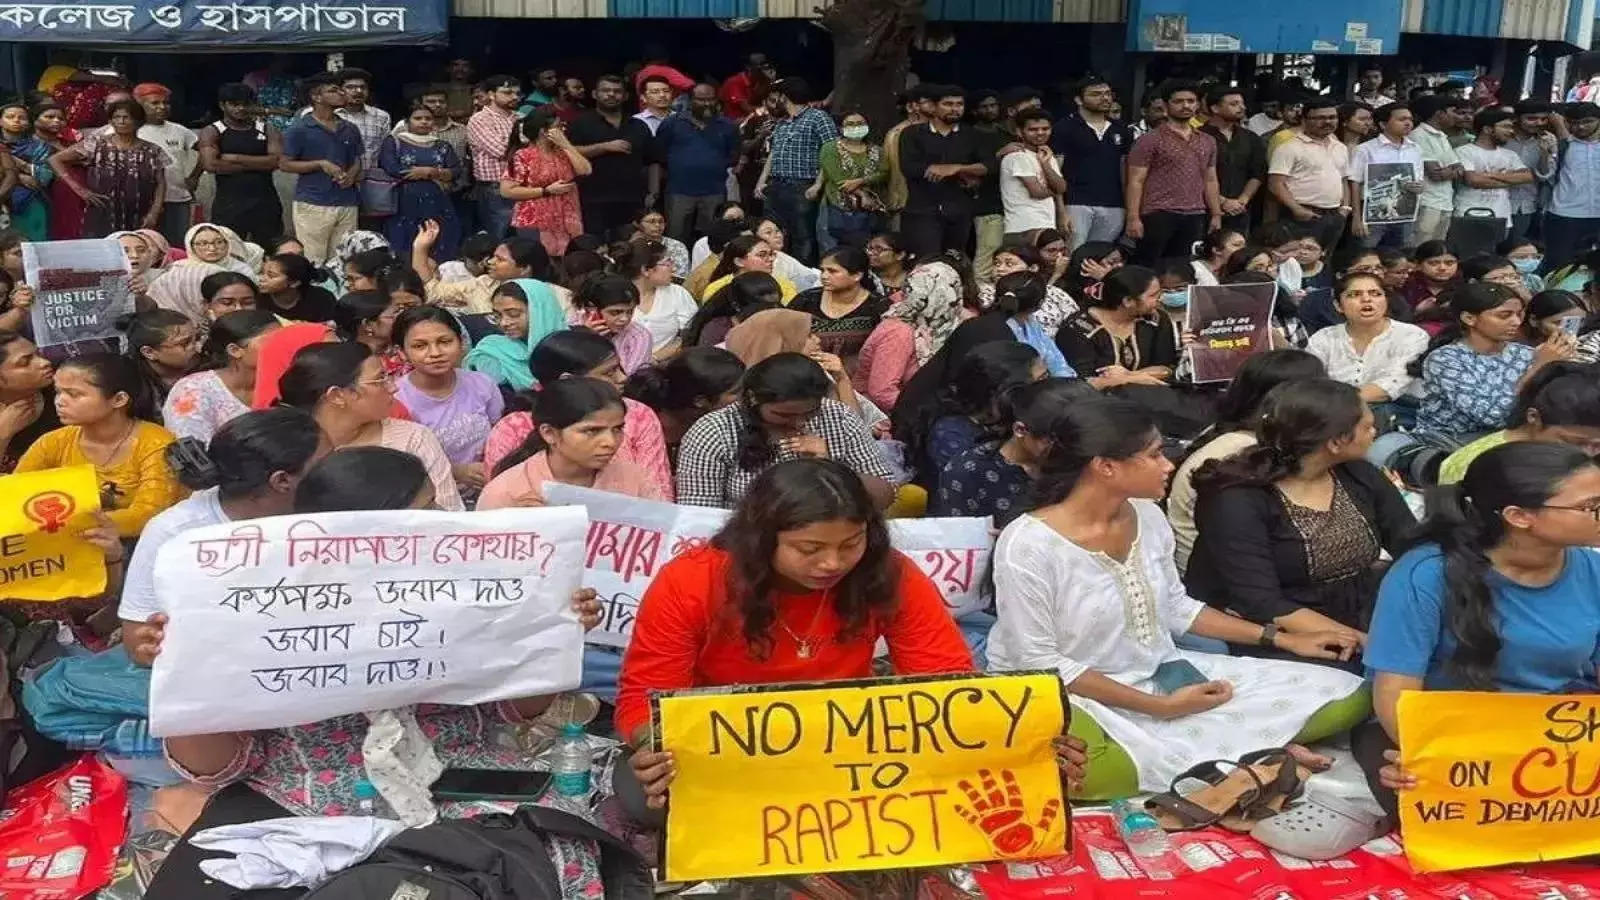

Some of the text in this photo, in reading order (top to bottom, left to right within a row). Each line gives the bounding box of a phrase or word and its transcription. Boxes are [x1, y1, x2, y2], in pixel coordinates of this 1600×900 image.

[0, 2, 406, 32] কলেজ ও হাসপাতাল
[46, 289, 105, 305] JUSTICE
[46, 304, 74, 318] FOR
[47, 314, 97, 330] VICTIM
[189, 524, 270, 577] ছাত্রী
[219, 577, 524, 618] কর্তৃপক্ষ জবাব দাও
[261, 623, 356, 653] জবাব
[250, 663, 347, 693] জবাব
[708, 685, 1033, 756] NO MERCY
[834, 762, 909, 792] TO
[1449, 760, 1492, 788] ON
[1414, 800, 1467, 824] WE
[758, 789, 948, 866] RAPIST
